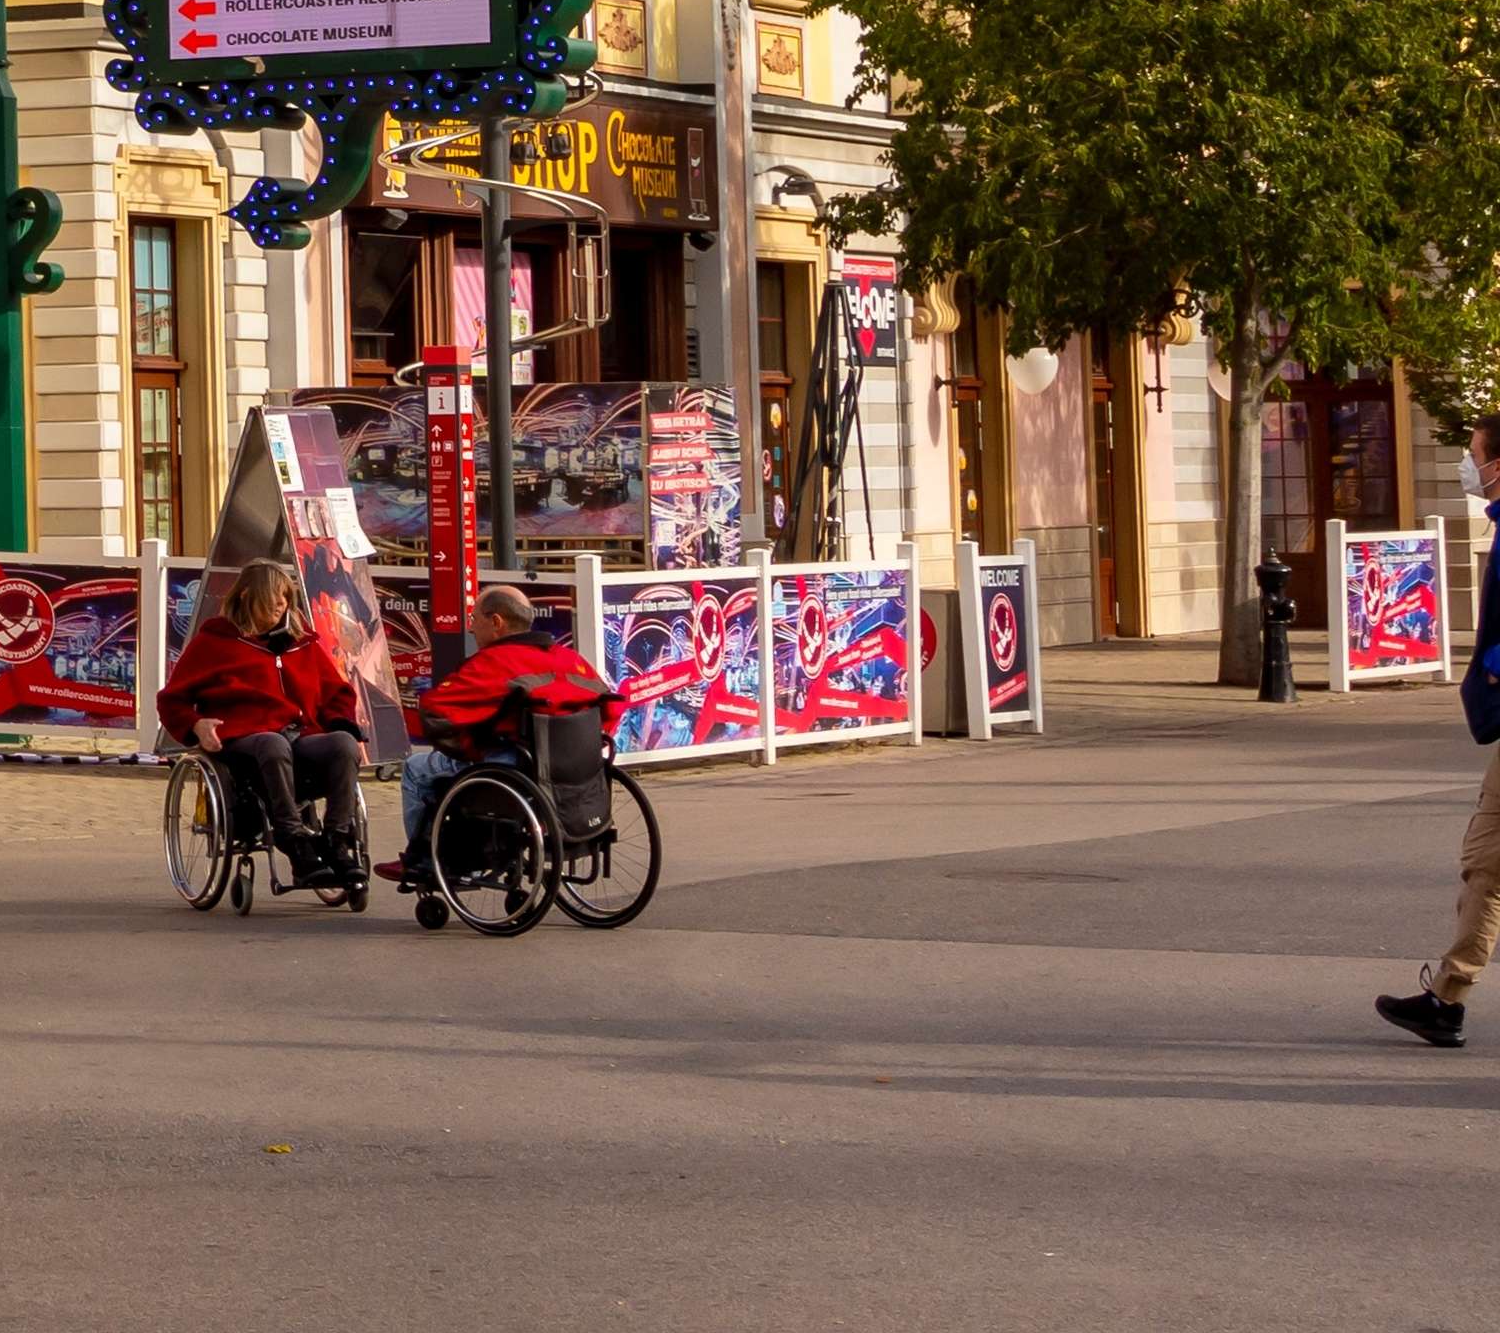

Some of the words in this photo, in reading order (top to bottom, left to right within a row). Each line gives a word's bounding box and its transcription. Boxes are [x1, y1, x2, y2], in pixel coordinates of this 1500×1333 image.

[226, 28, 319, 46] CHOCOLATE
[323, 24, 393, 41] MUSEUM
[607, 110, 676, 177] CHOCOLATE
[632, 165, 678, 219] MUSEUM
[980, 569, 1020, 587] WELCOME
[385, 599, 415, 611] dein
[29, 684, 133, 708] www.rollercoaster.rest
